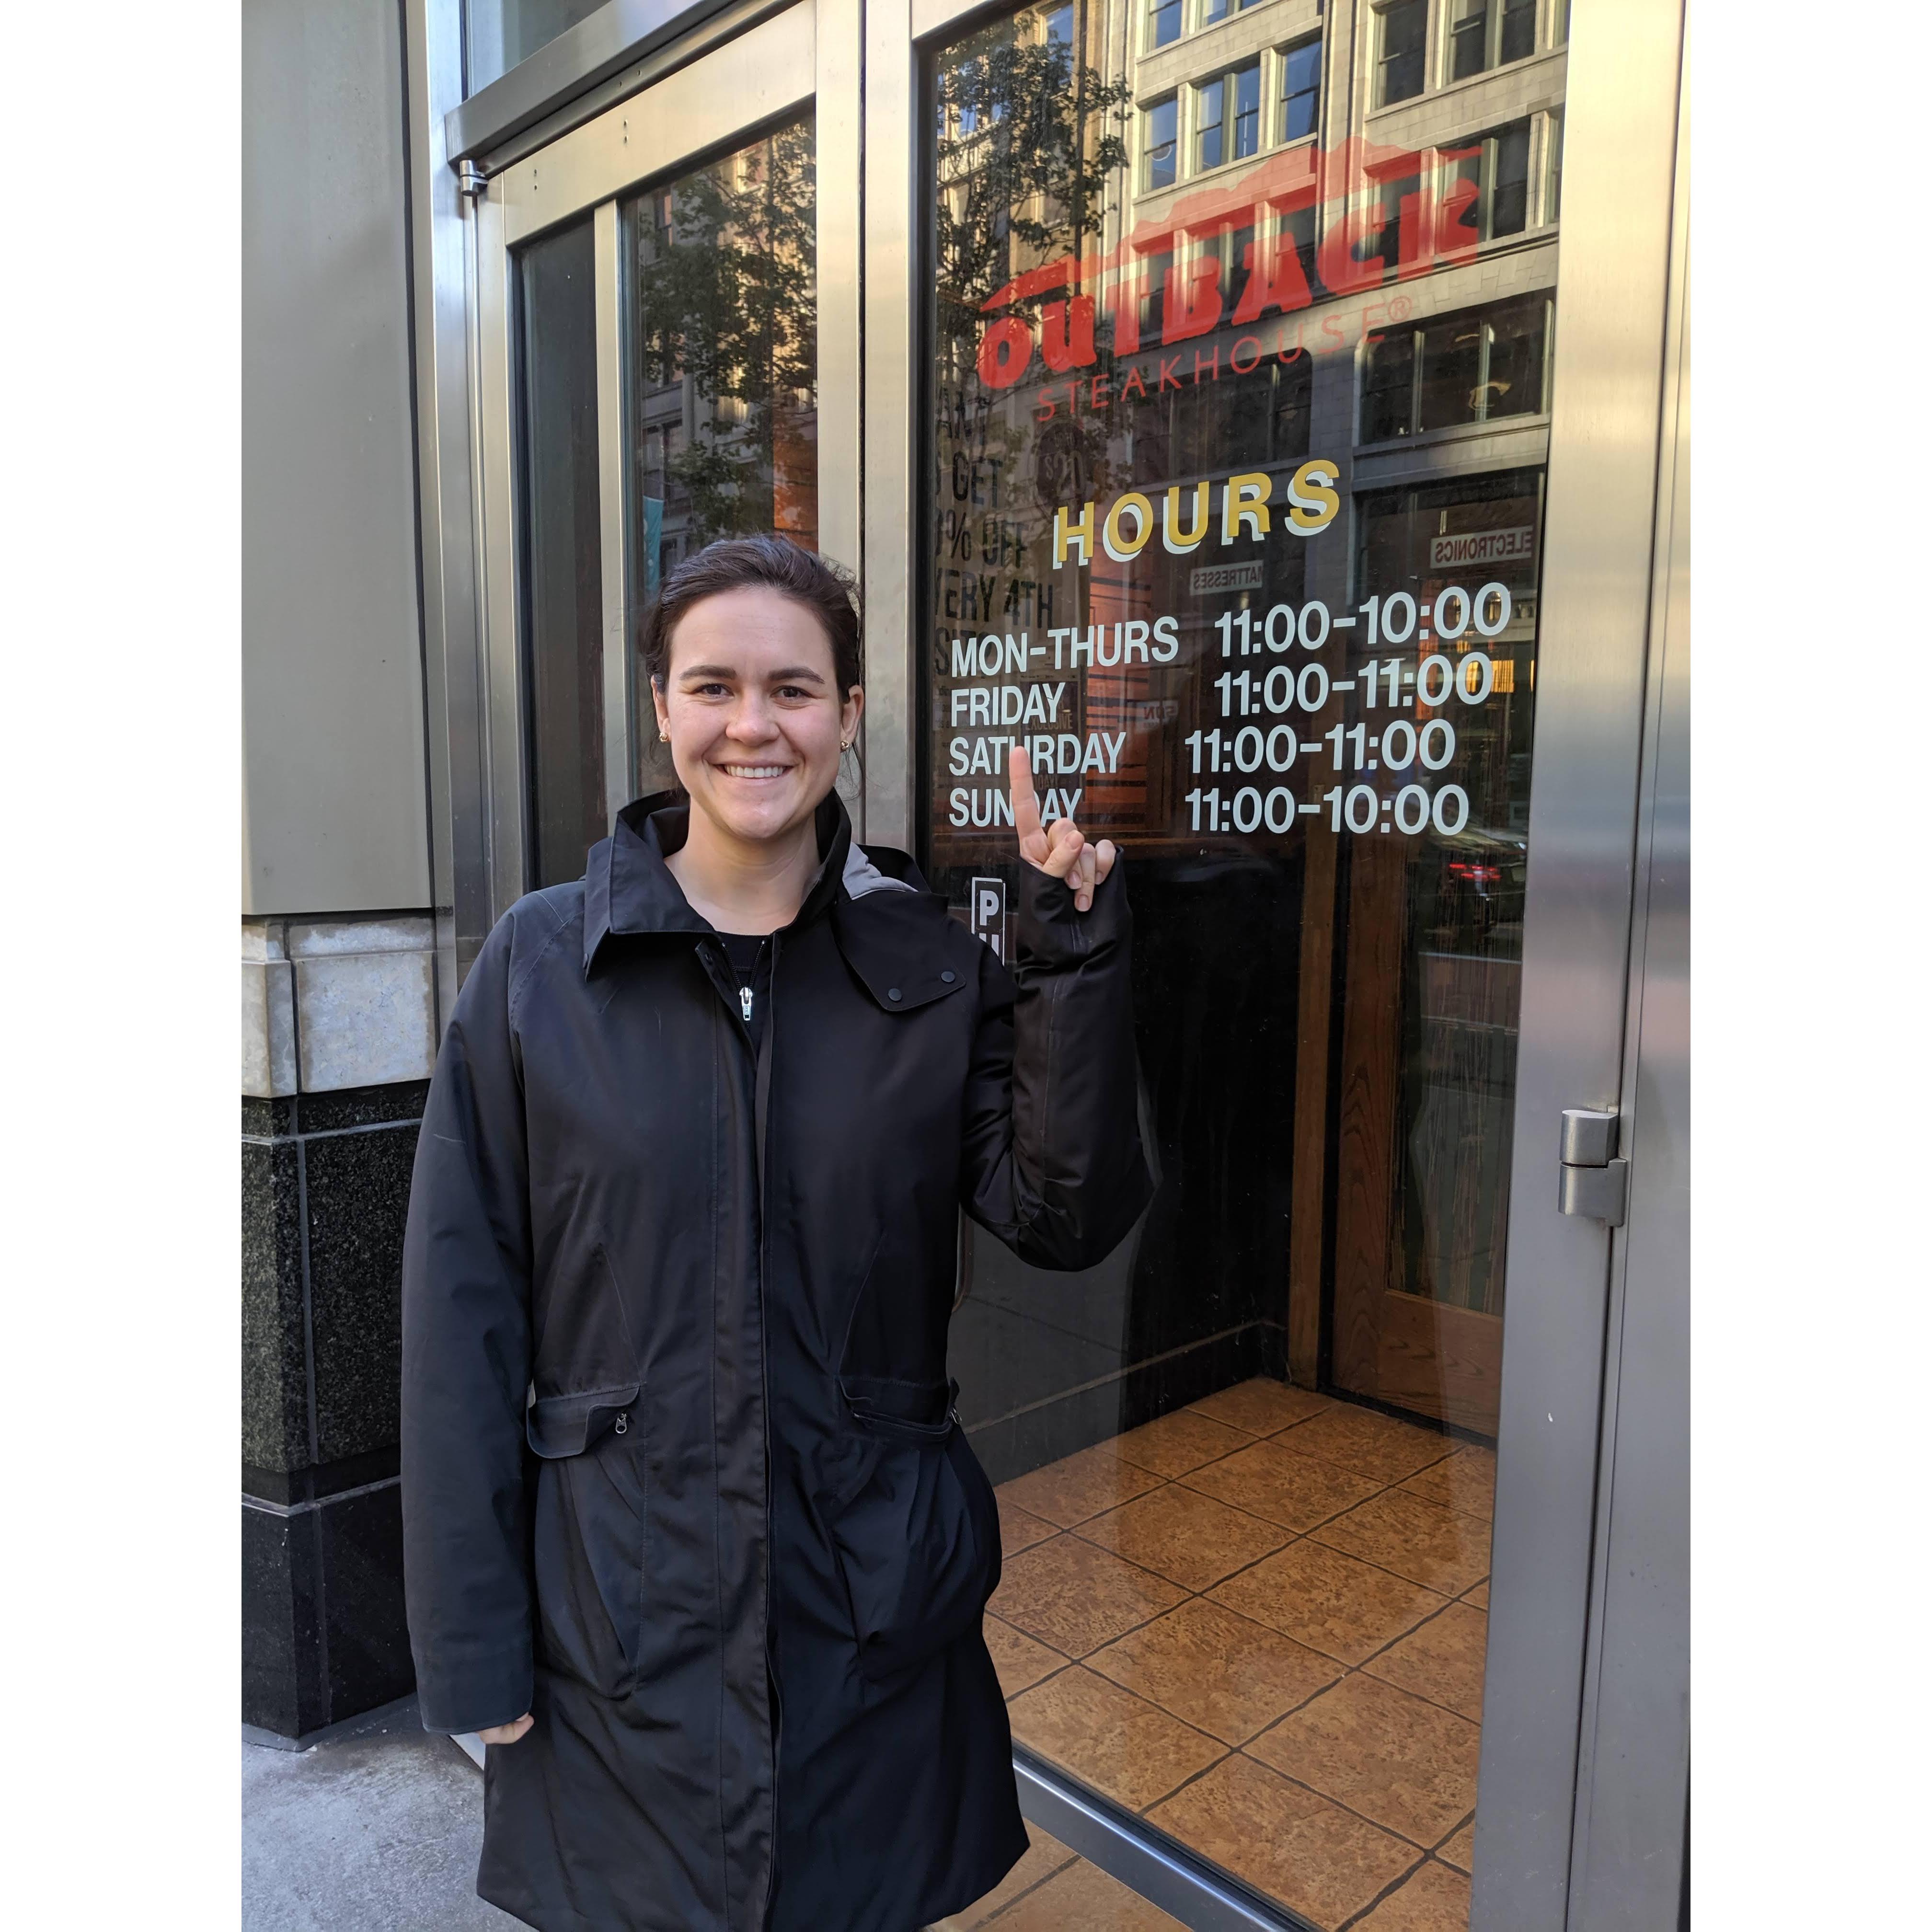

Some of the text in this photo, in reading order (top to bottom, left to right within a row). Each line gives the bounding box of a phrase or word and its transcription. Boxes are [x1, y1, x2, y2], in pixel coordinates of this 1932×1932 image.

[1053, 459, 1340, 569] HOURS
[952, 616, 1179, 678] MON-THURS
[1215, 582, 1511, 657] 11:00-10:00
[1003, 579, 1053, 629] 4TH
[951, 682, 1066, 727] FRIDAY
[1215, 652, 1493, 717] 11:00-11:00
[1185, 719, 1456, 773] 11:00-11:00
[949, 784, 1469, 836] SUNAY 11:00-10:00
